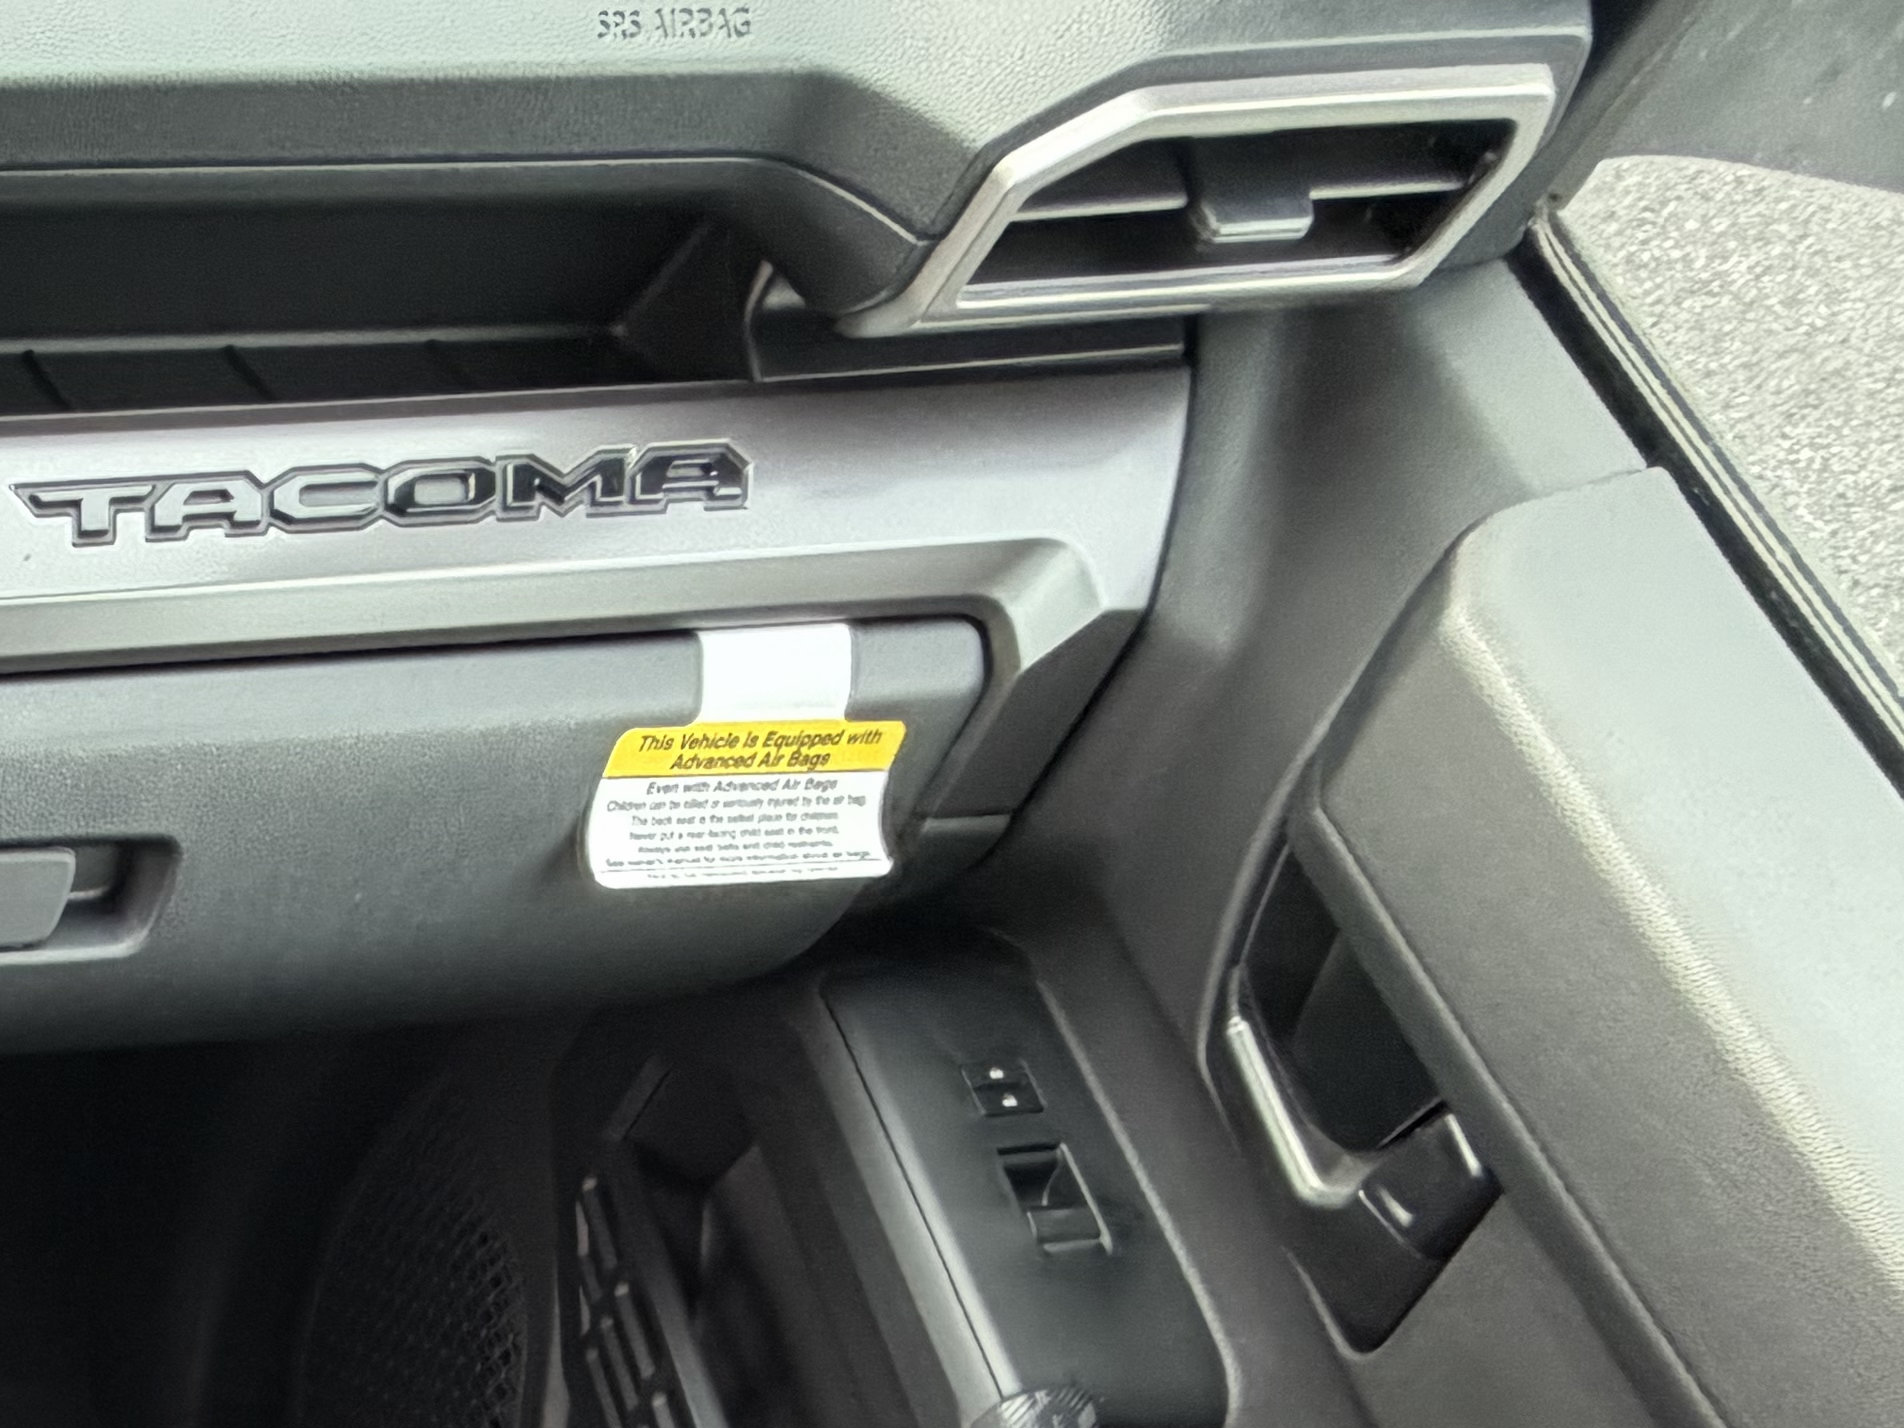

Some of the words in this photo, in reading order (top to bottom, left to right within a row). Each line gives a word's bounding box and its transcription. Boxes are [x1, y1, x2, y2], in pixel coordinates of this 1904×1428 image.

[597, 10, 641, 39] SRS
[654, 8, 752, 39] AIRBAG
[9, 438, 754, 547] TACOMA
[639, 735, 673, 752] This
[680, 732, 739, 751] Vehicle
[762, 729, 844, 752] Equipped
[847, 729, 883, 745] with
[670, 752, 756, 771] Advanced
[758, 751, 784, 768] Air
[787, 752, 831, 771] Bags
[714, 779, 780, 793] Advanced
[782, 778, 801, 791] Air
